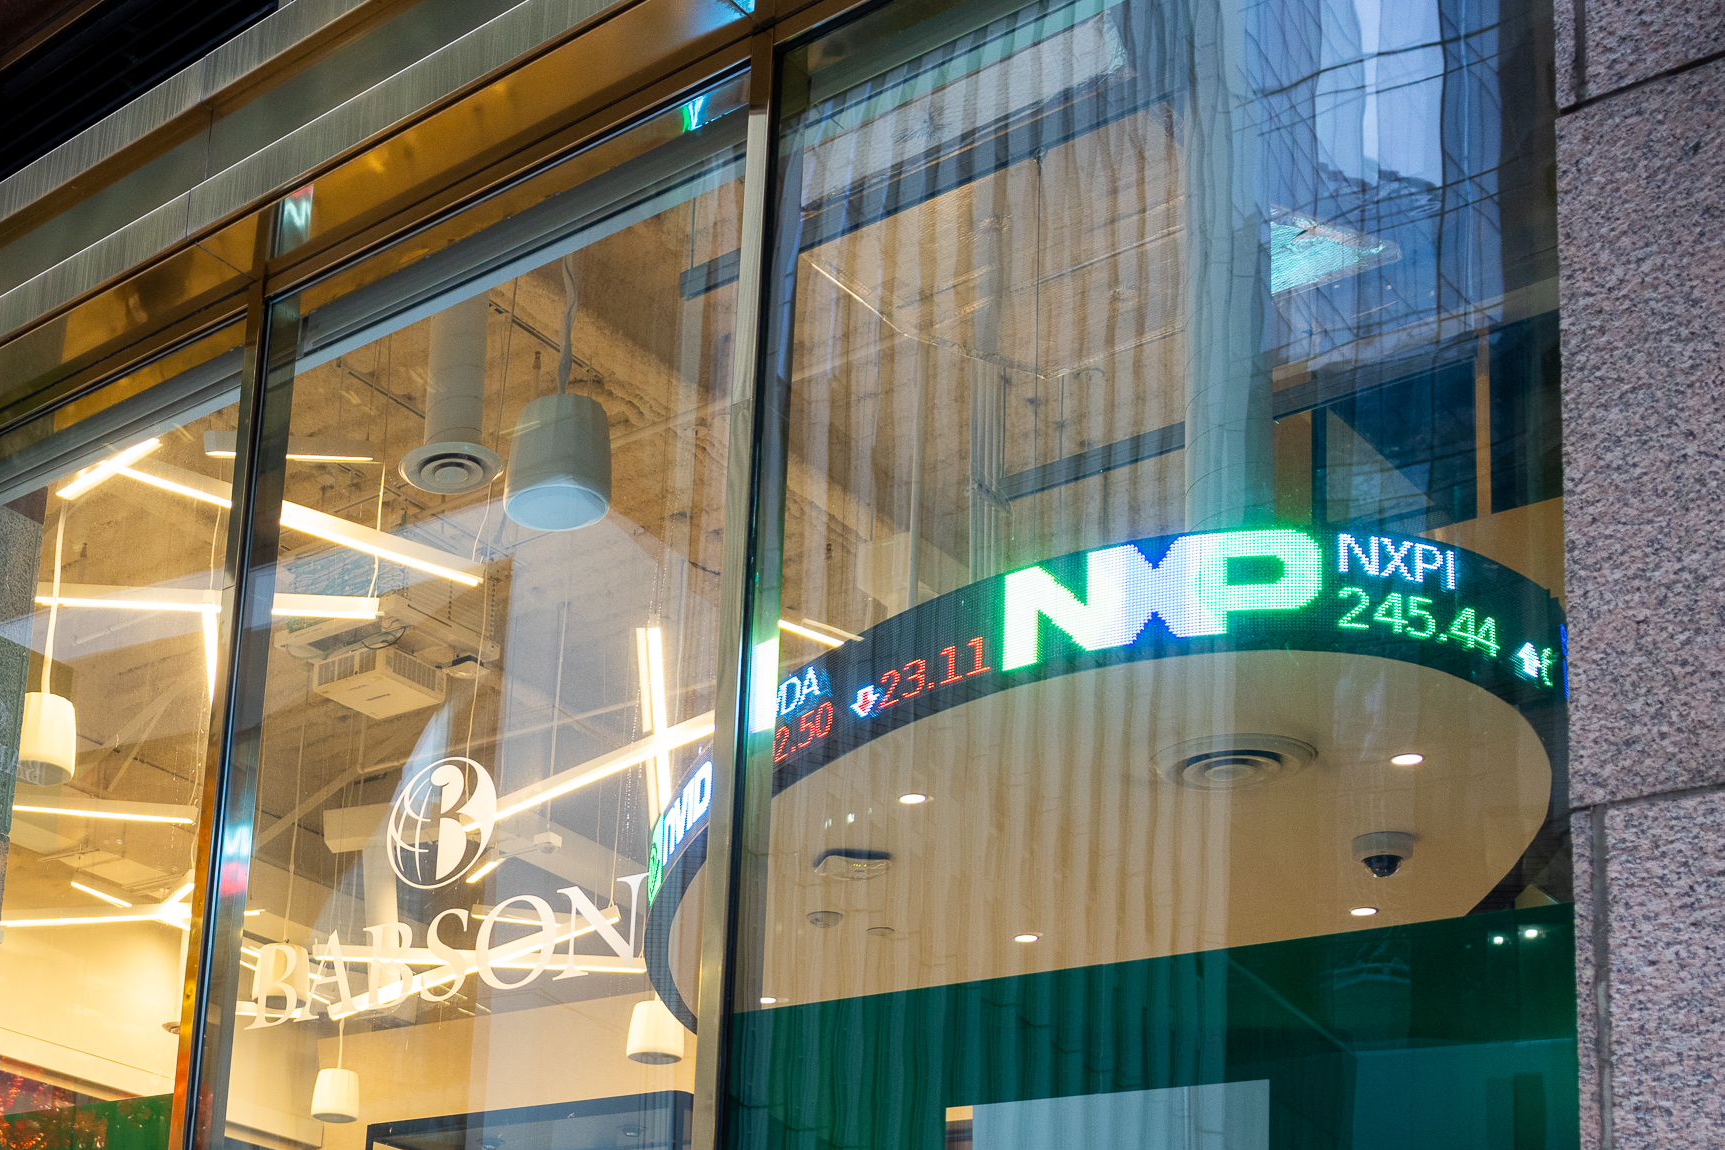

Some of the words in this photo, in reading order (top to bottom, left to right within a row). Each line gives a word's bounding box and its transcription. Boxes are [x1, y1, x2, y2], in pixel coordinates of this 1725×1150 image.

[1337, 532, 1457, 590] NXPI
[1004, 528, 1323, 671] NXP
[1337, 587, 1500, 657] 245.44
[776, 666, 821, 717] DA
[879, 636, 991, 709] 23.11
[772, 701, 834, 763] 2.50
[244, 872, 650, 1030] BABSON
